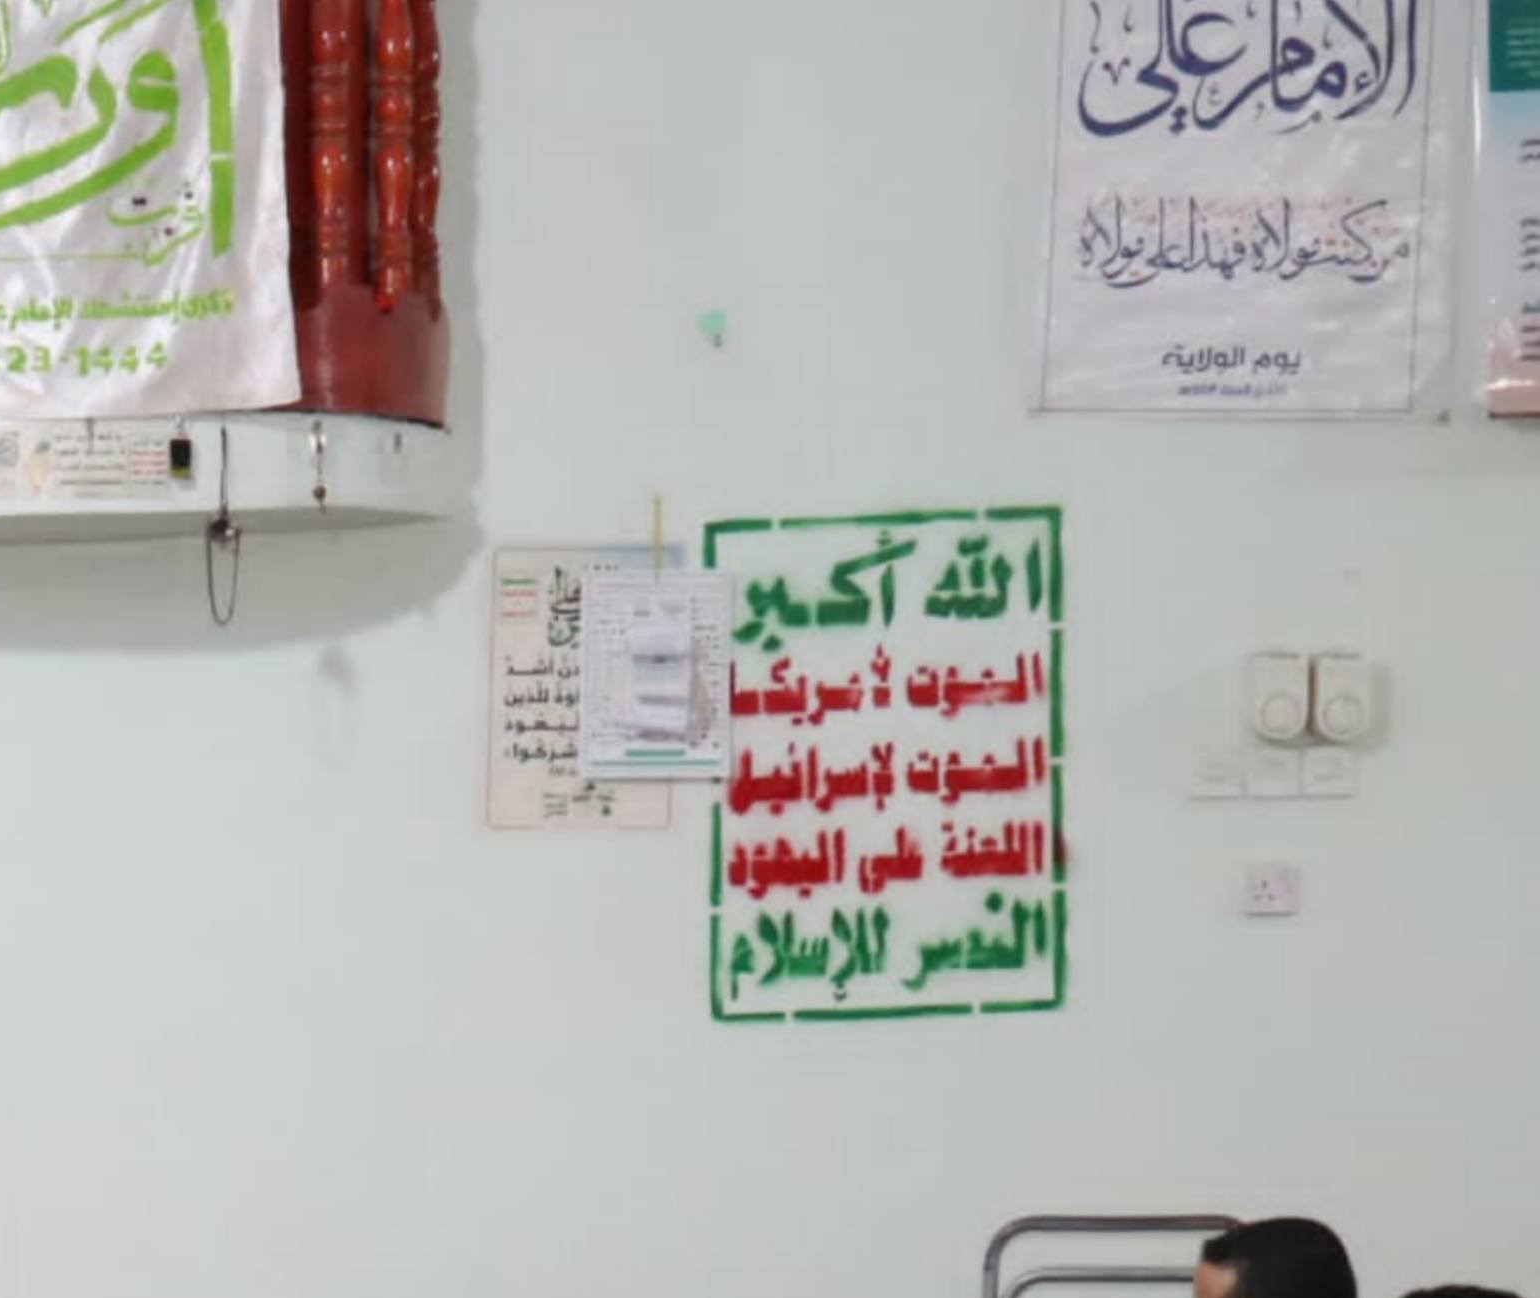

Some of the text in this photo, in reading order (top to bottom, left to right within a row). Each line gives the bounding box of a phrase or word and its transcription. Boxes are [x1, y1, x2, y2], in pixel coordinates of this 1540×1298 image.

[1161, 344, 1302, 376] يوم الولاية
[730, 529, 1045, 654] الله أكبر
